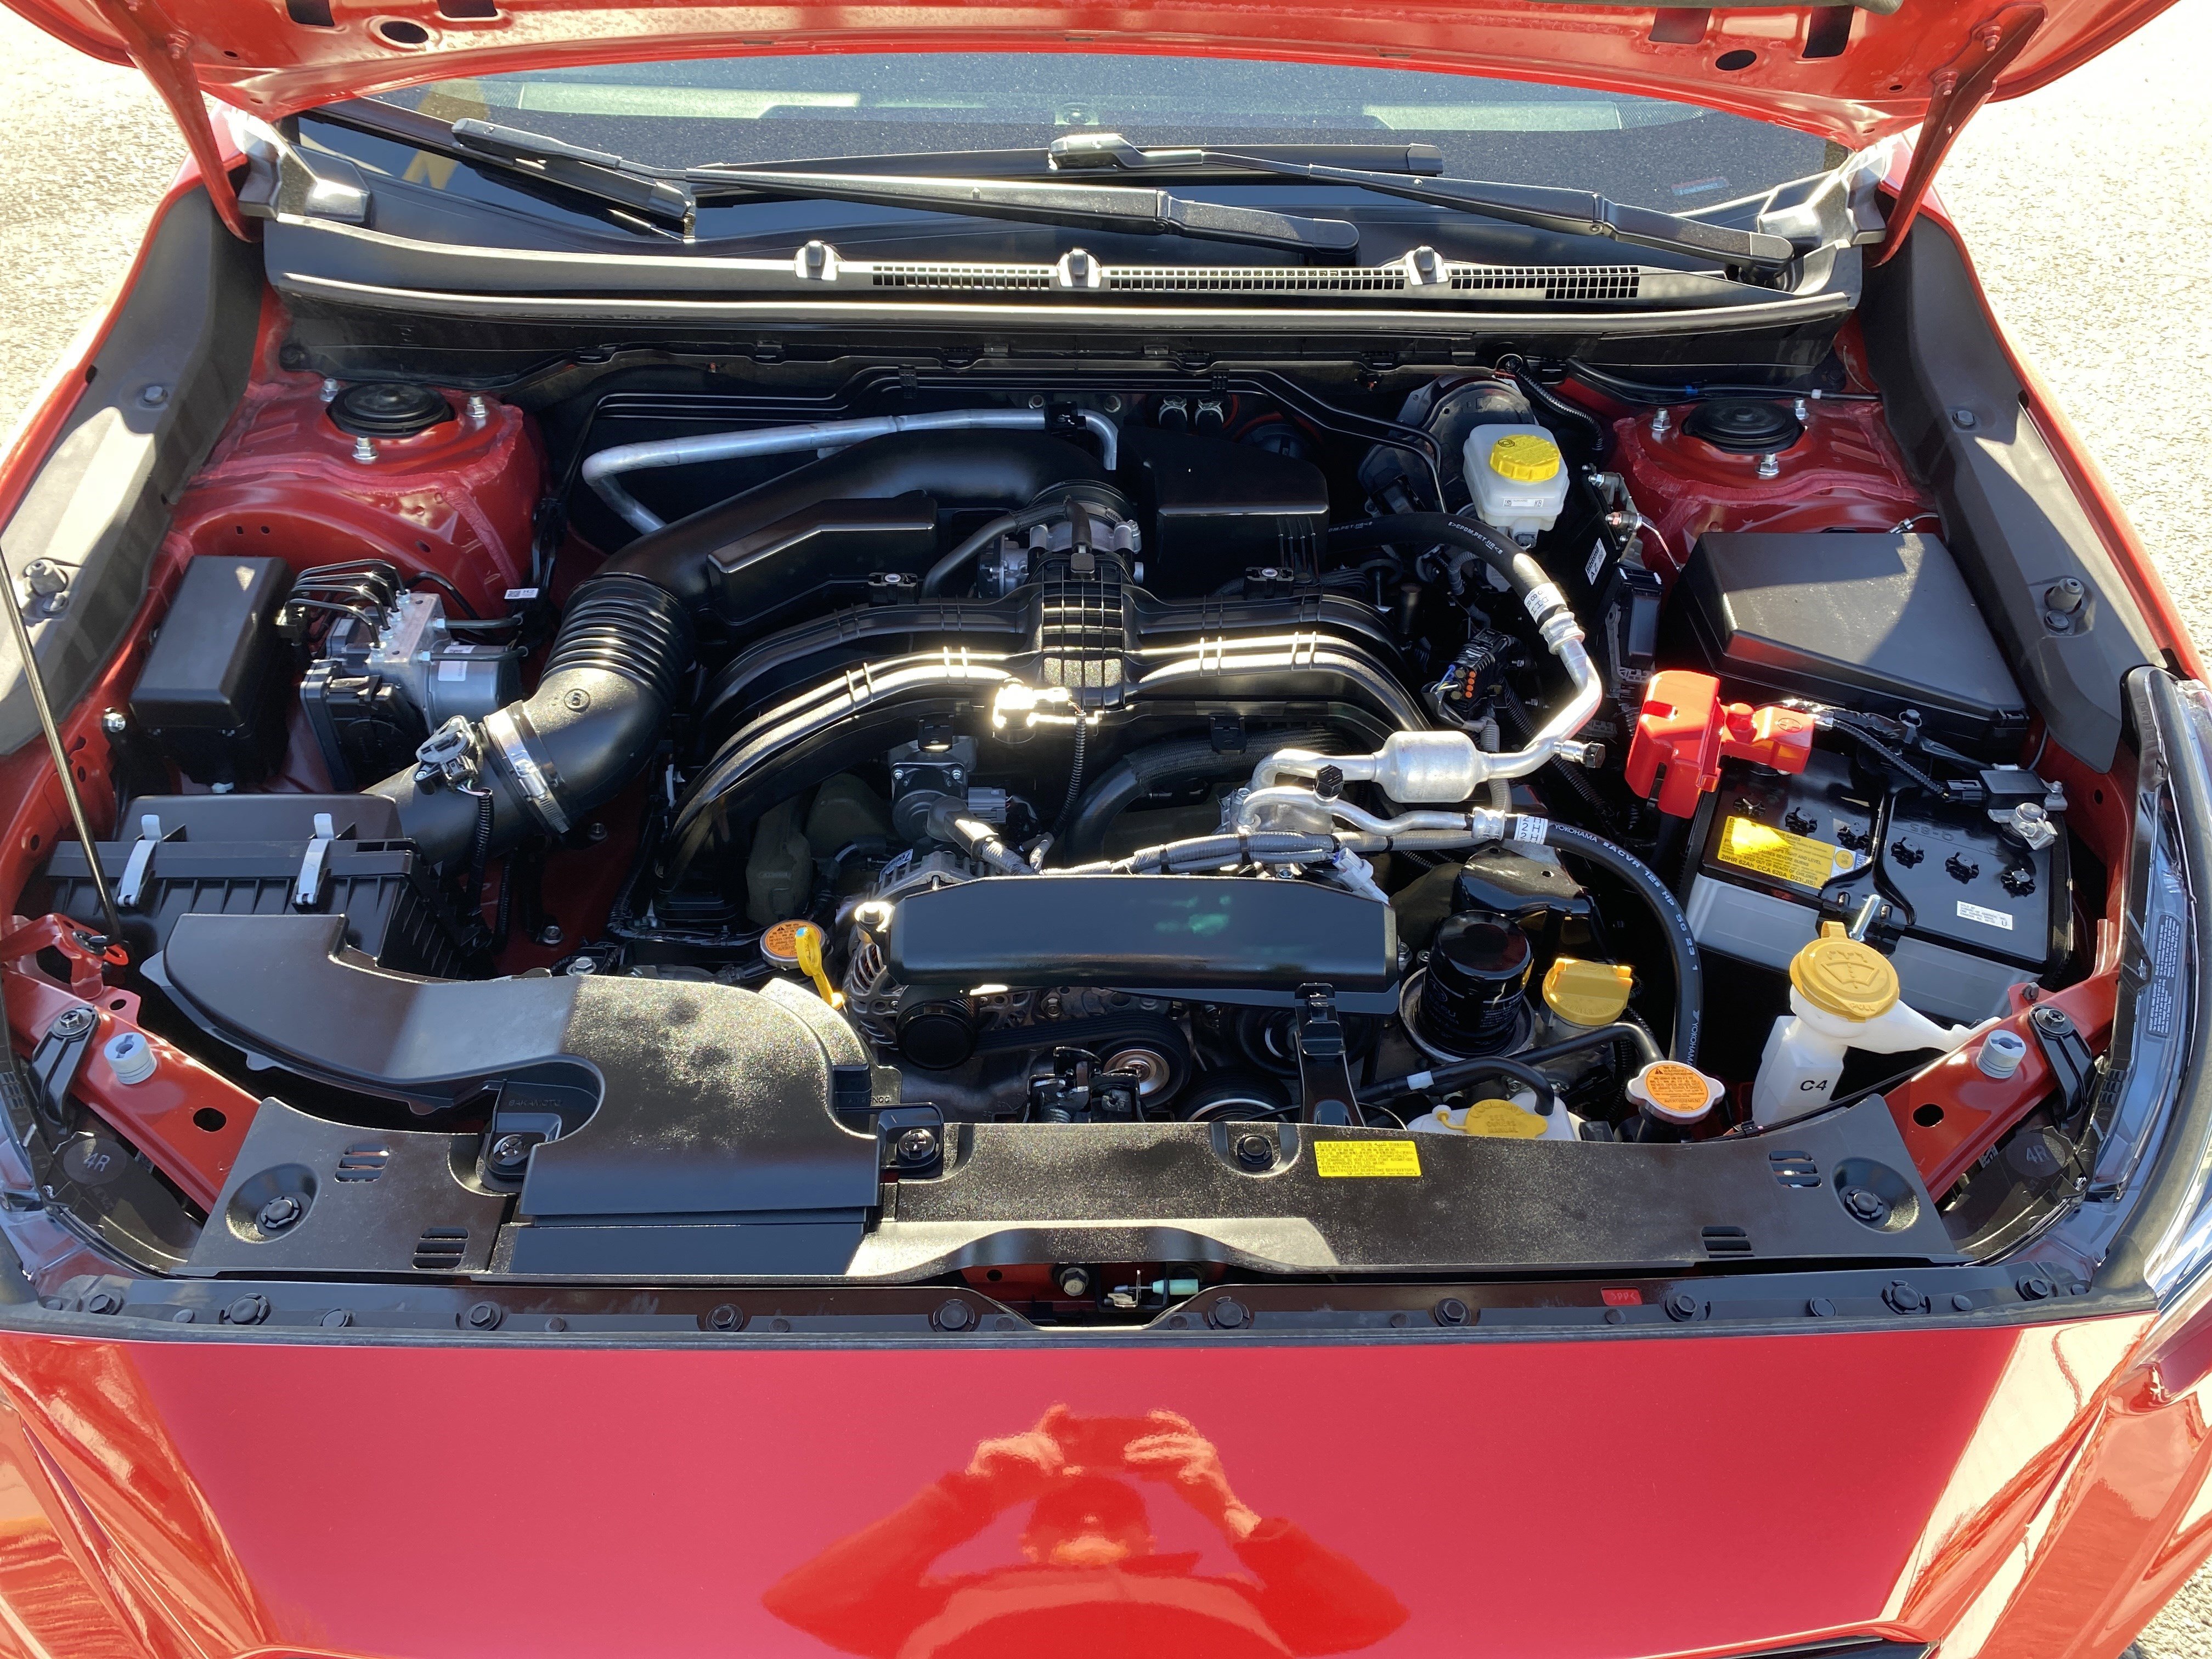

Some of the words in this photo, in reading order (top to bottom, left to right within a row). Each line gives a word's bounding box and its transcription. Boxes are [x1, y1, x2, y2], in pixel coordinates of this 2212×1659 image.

[1721, 854, 1737, 863] 20HR
[1739, 860, 1754, 868] 62Ah
[1772, 869, 1787, 878] 620A
[1555, 824, 1598, 843] YOKOHAMA
[1661, 890, 1674, 906] HP
[1685, 938, 1695, 956] 23
[1686, 1022, 1699, 1065] YOKOHAMA
[1800, 1079, 1827, 1092] C4
[1470, 1101, 1526, 1118] COOLANT
[83, 1153, 110, 1172] 4R
[2026, 1145, 2050, 1164] 4R
